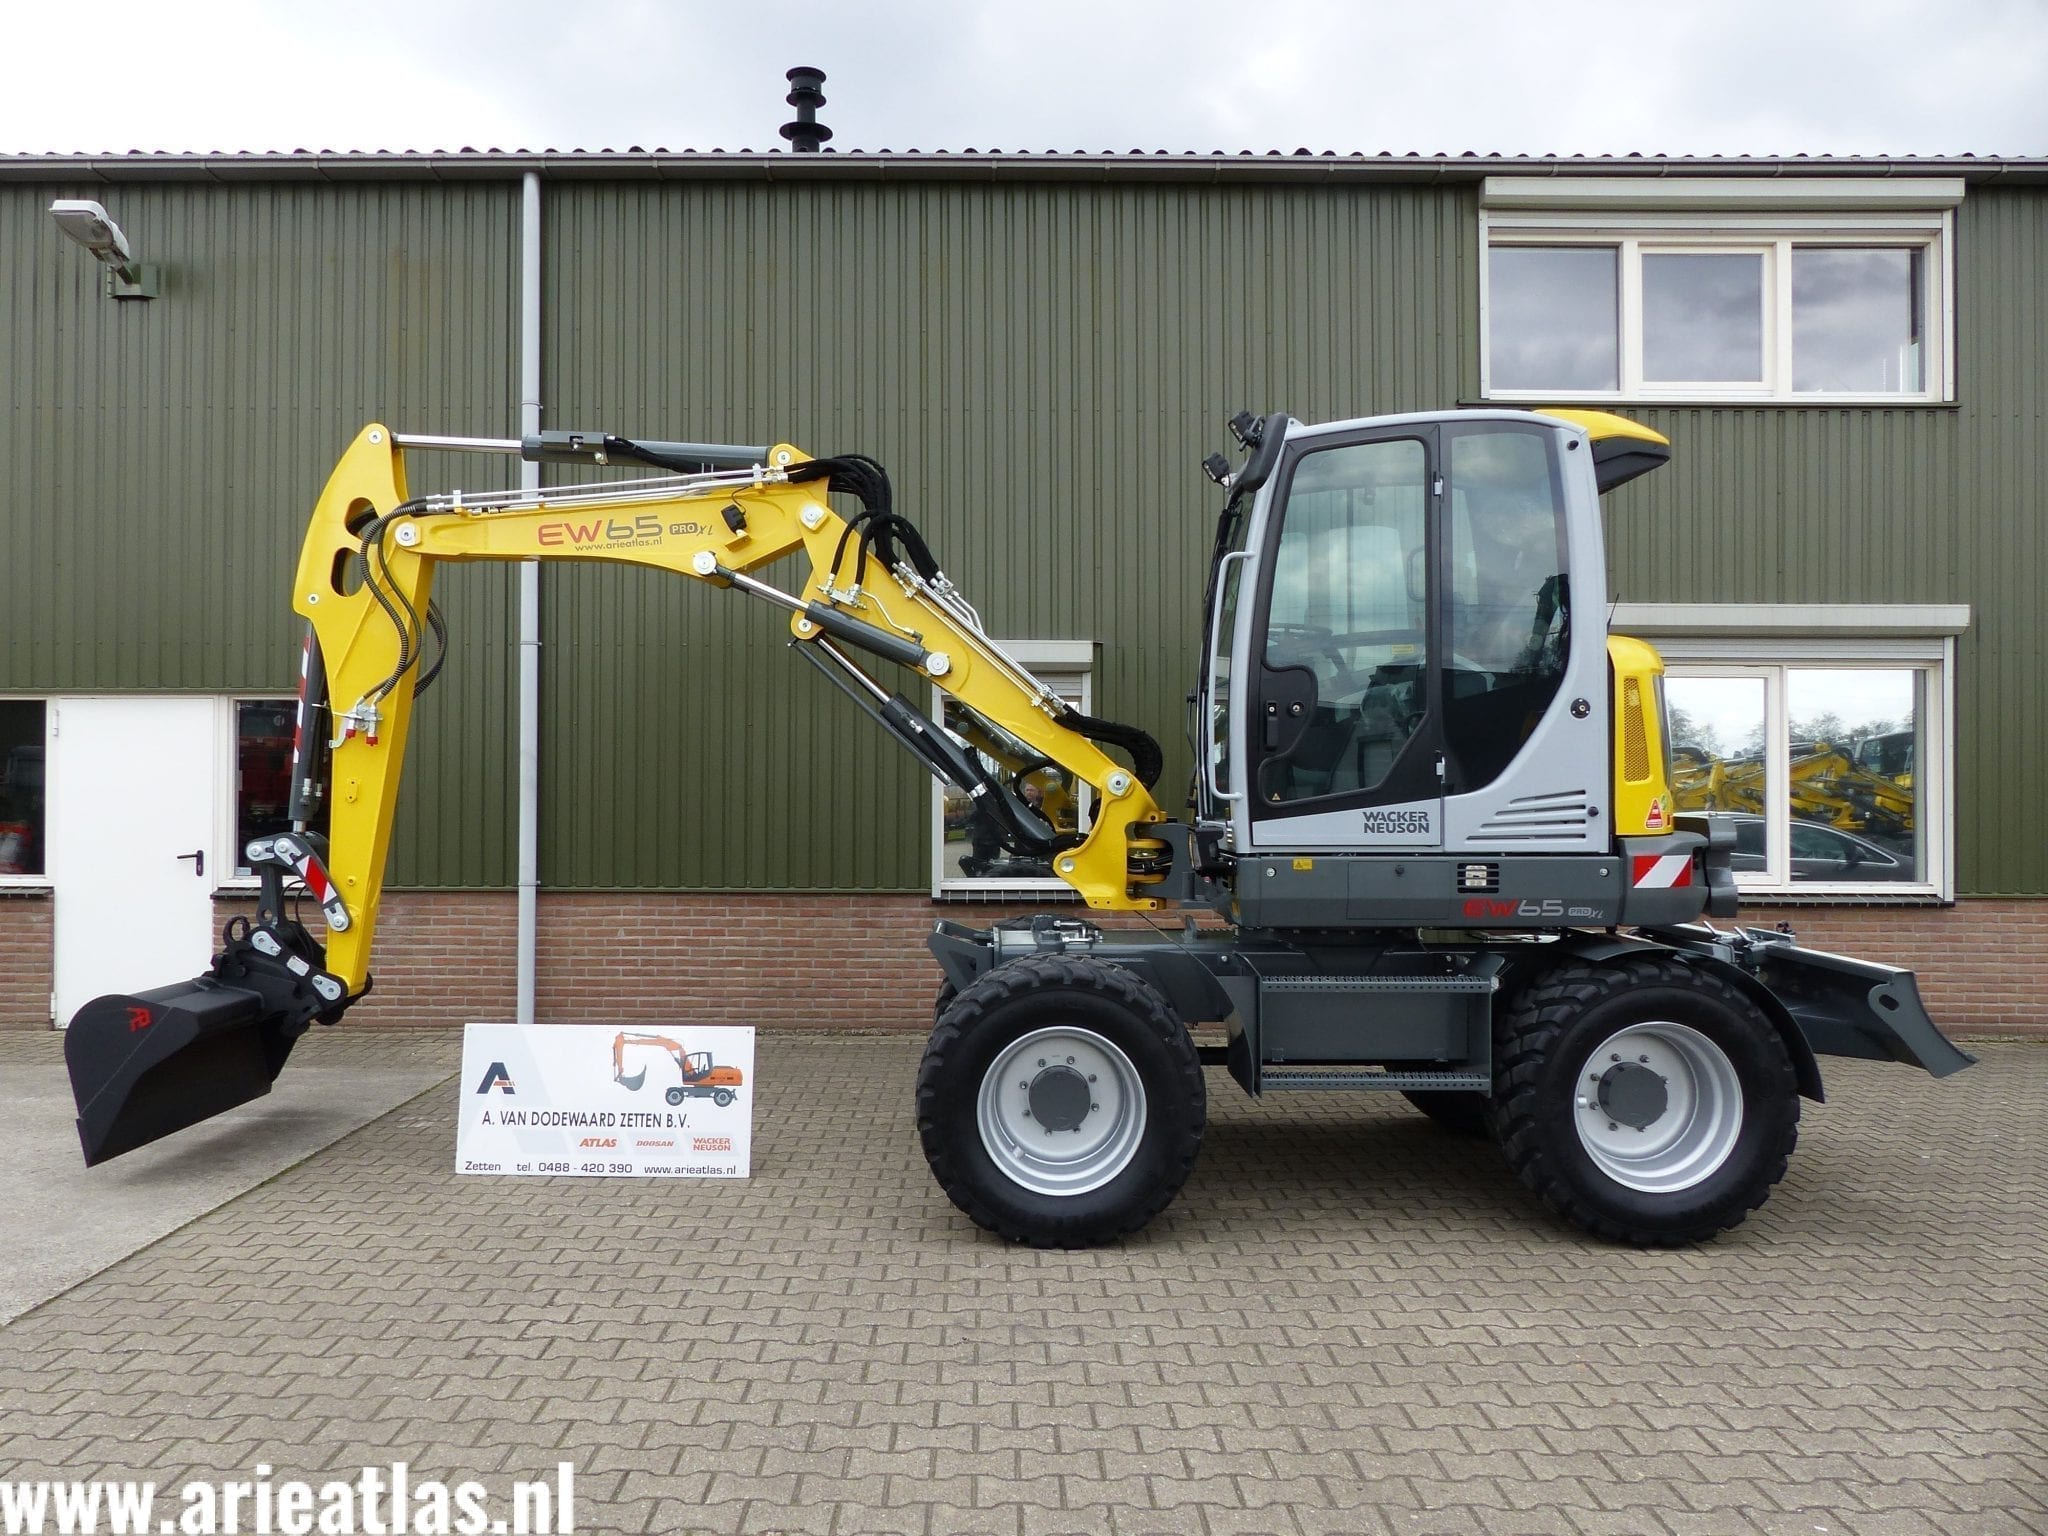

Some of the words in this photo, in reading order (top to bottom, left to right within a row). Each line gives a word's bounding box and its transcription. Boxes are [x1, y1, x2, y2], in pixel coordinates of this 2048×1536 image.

[538, 515, 663, 546] EW65
[670, 523, 697, 535] PRO
[575, 536, 663, 552] www.arieatlas.nl
[1362, 811, 1429, 822] WACKER
[1363, 822, 1430, 834] NEUSON
[1463, 899, 1564, 918] EW65
[1569, 907, 1590, 916] PRO
[482, 1111, 495, 1126] A.
[500, 1111, 526, 1126] VAN
[531, 1111, 616, 1127] DODEWAARD
[620, 1113, 662, 1128] ZETTEN
[666, 1114, 690, 1128] B.V.
[579, 1138, 618, 1148] ATLAS
[693, 1137, 730, 1145] WACKER
[465, 1161, 501, 1171] Zetten
[538, 1162, 570, 1172] 0488
[581, 1163, 605, 1173] 420
[608, 1164, 633, 1174] 390
[644, 1165, 736, 1175] www.arieatlas.nl
